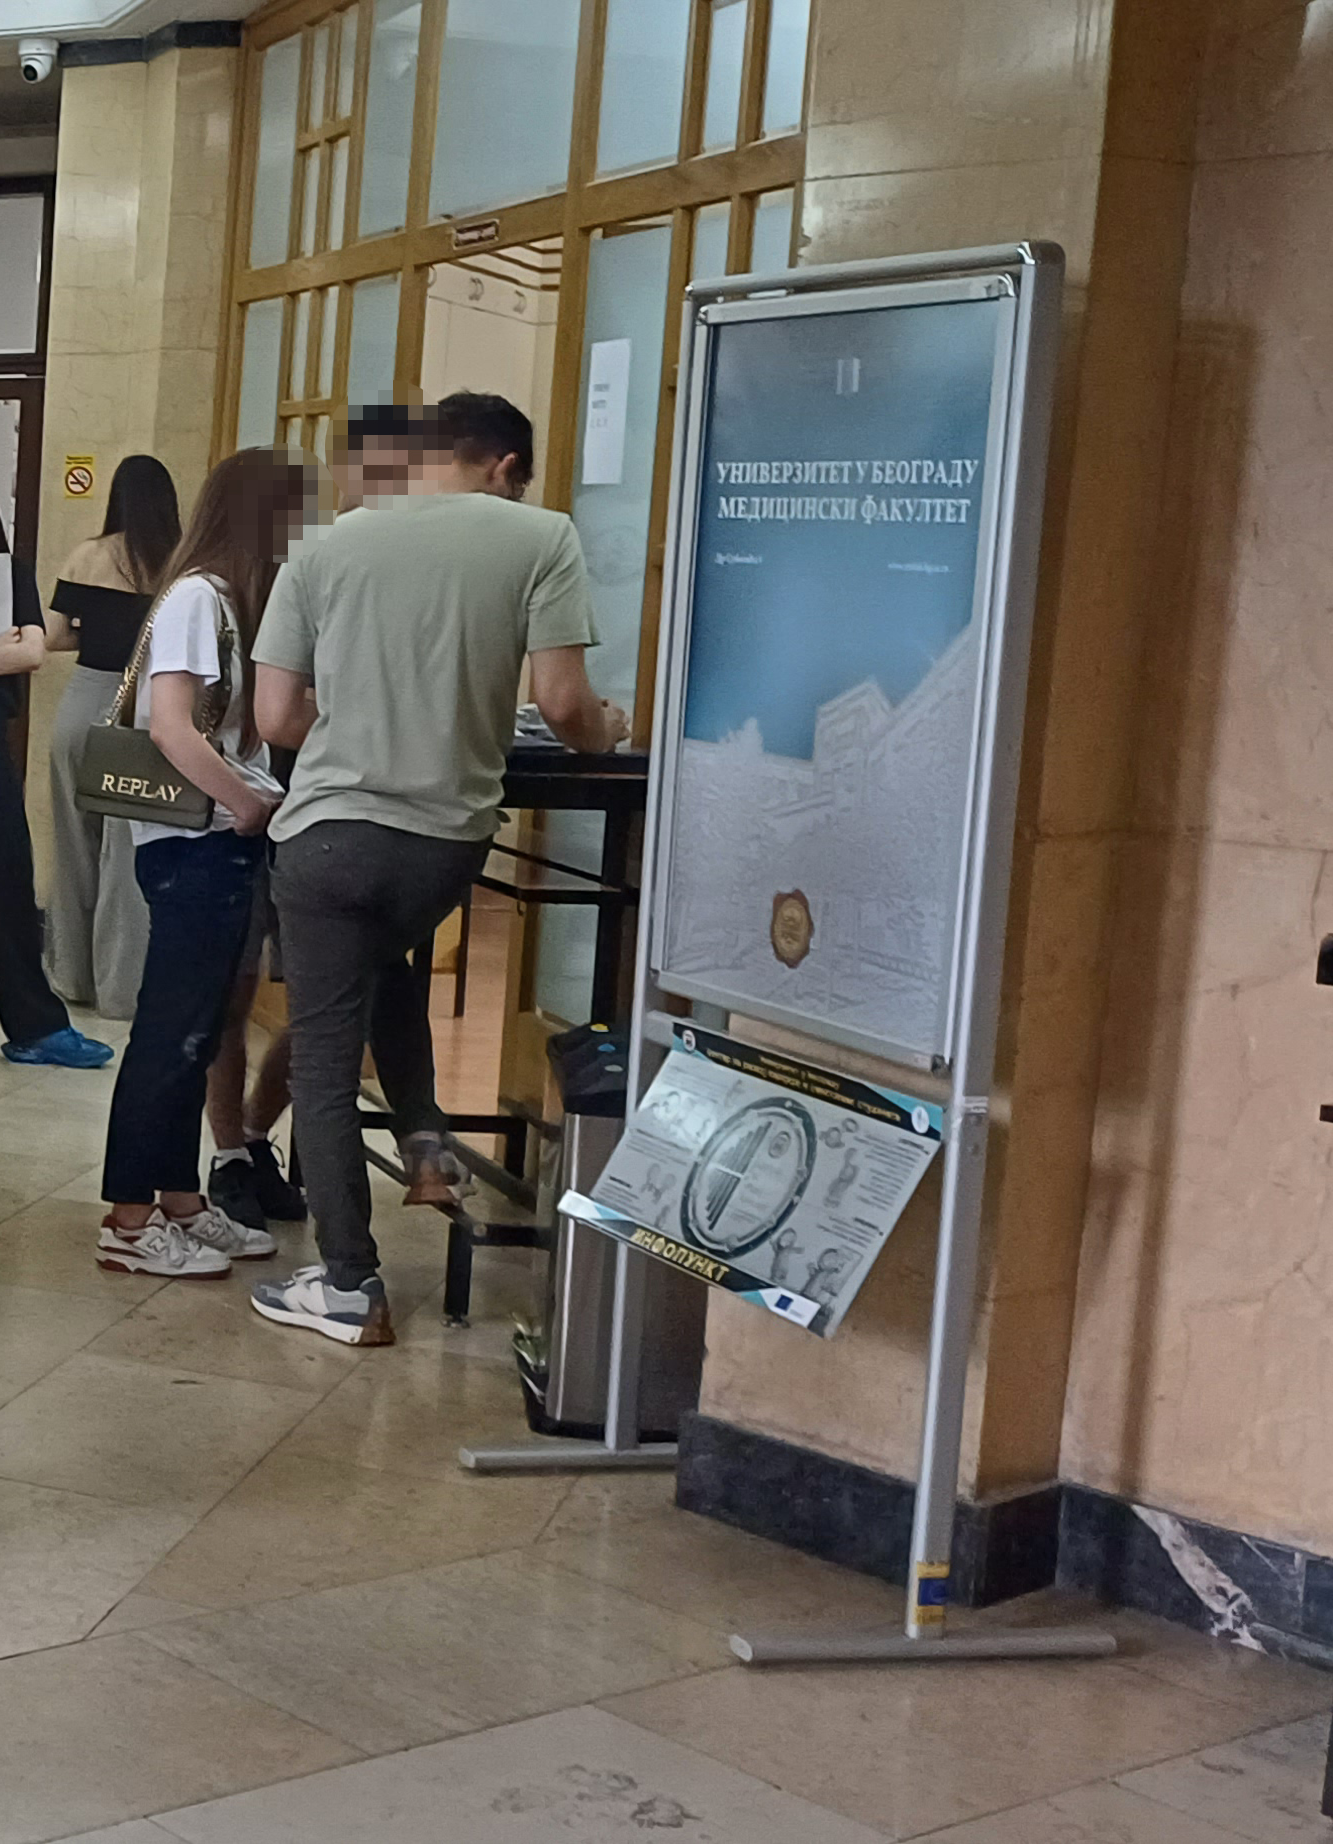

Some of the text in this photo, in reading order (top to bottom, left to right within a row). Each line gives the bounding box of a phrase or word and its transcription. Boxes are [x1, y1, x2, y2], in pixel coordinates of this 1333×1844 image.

[716, 459, 980, 488] УНИВЕРЗИТЕТ У БЕОГРАДУ
[717, 494, 972, 525] МЕДИЦИНСКИ ФАКУЛТЕТ
[100, 773, 183, 802] REPLAY
[629, 1227, 731, 1283] ИНФОПУНКТ
